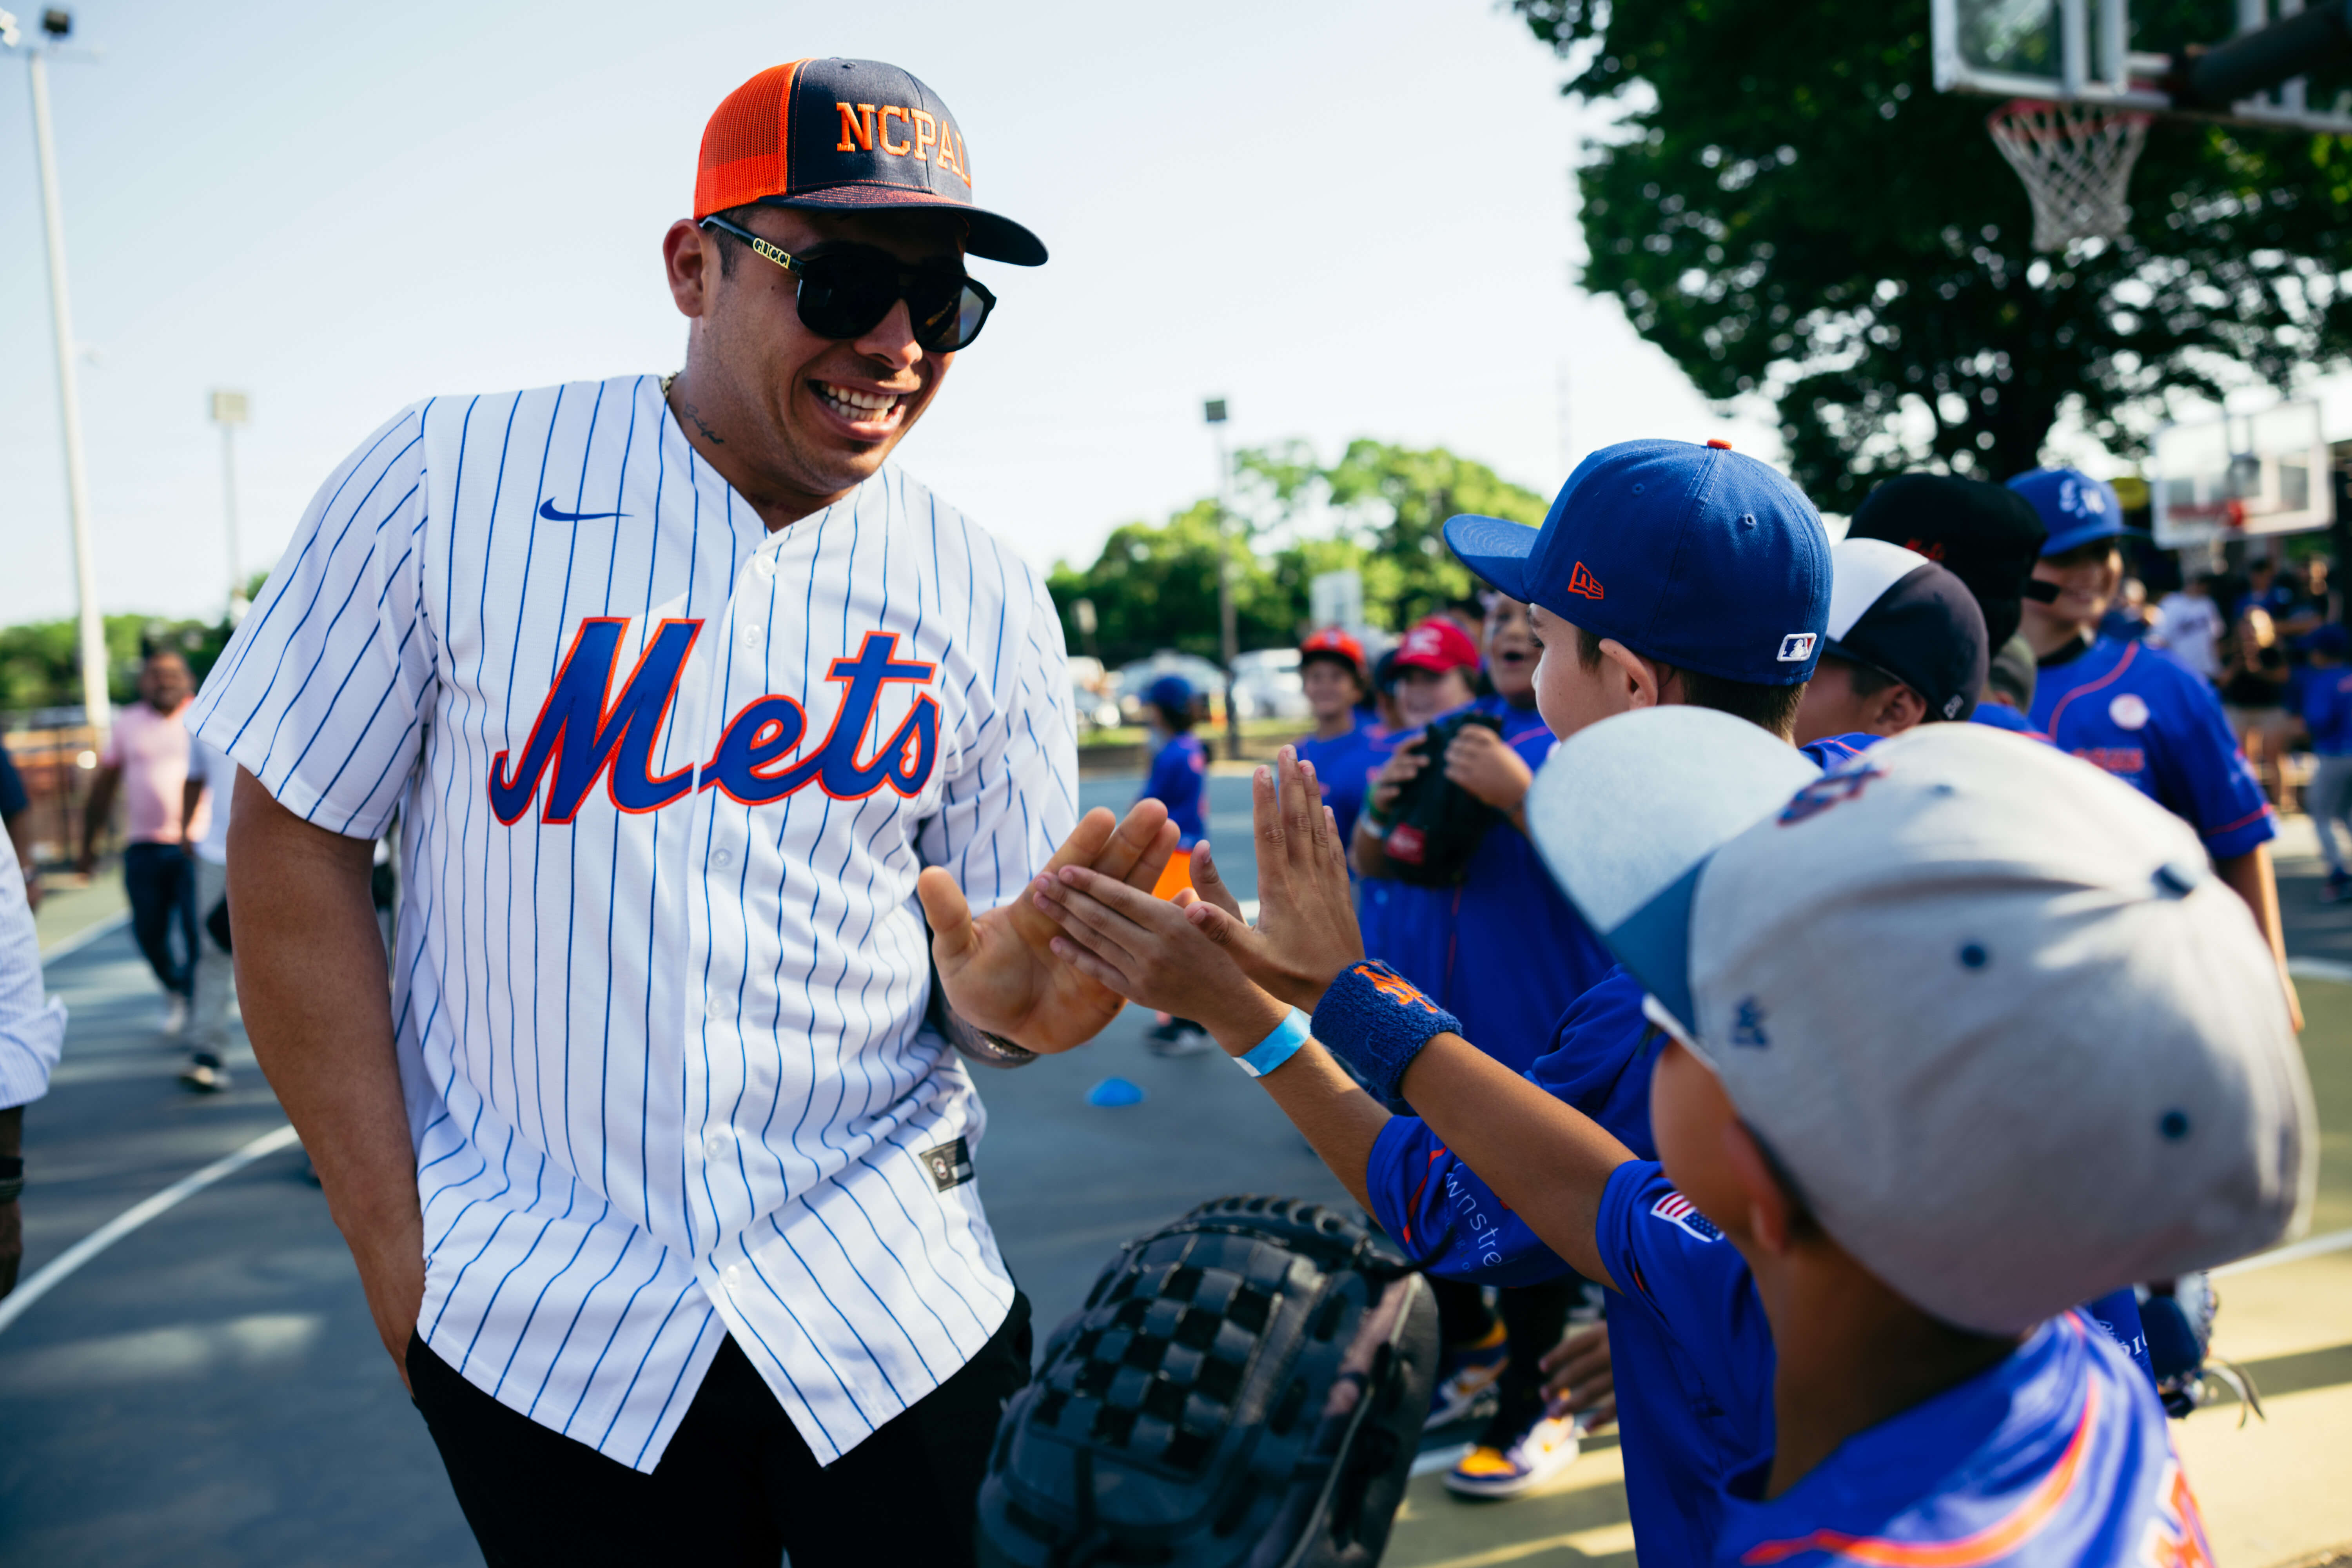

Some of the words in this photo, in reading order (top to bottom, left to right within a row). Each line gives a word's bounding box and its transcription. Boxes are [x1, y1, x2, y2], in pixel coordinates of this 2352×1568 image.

[837, 102, 971, 188] NCPAL
[753, 238, 791, 269] GUCCI
[489, 617, 940, 826] Mets
